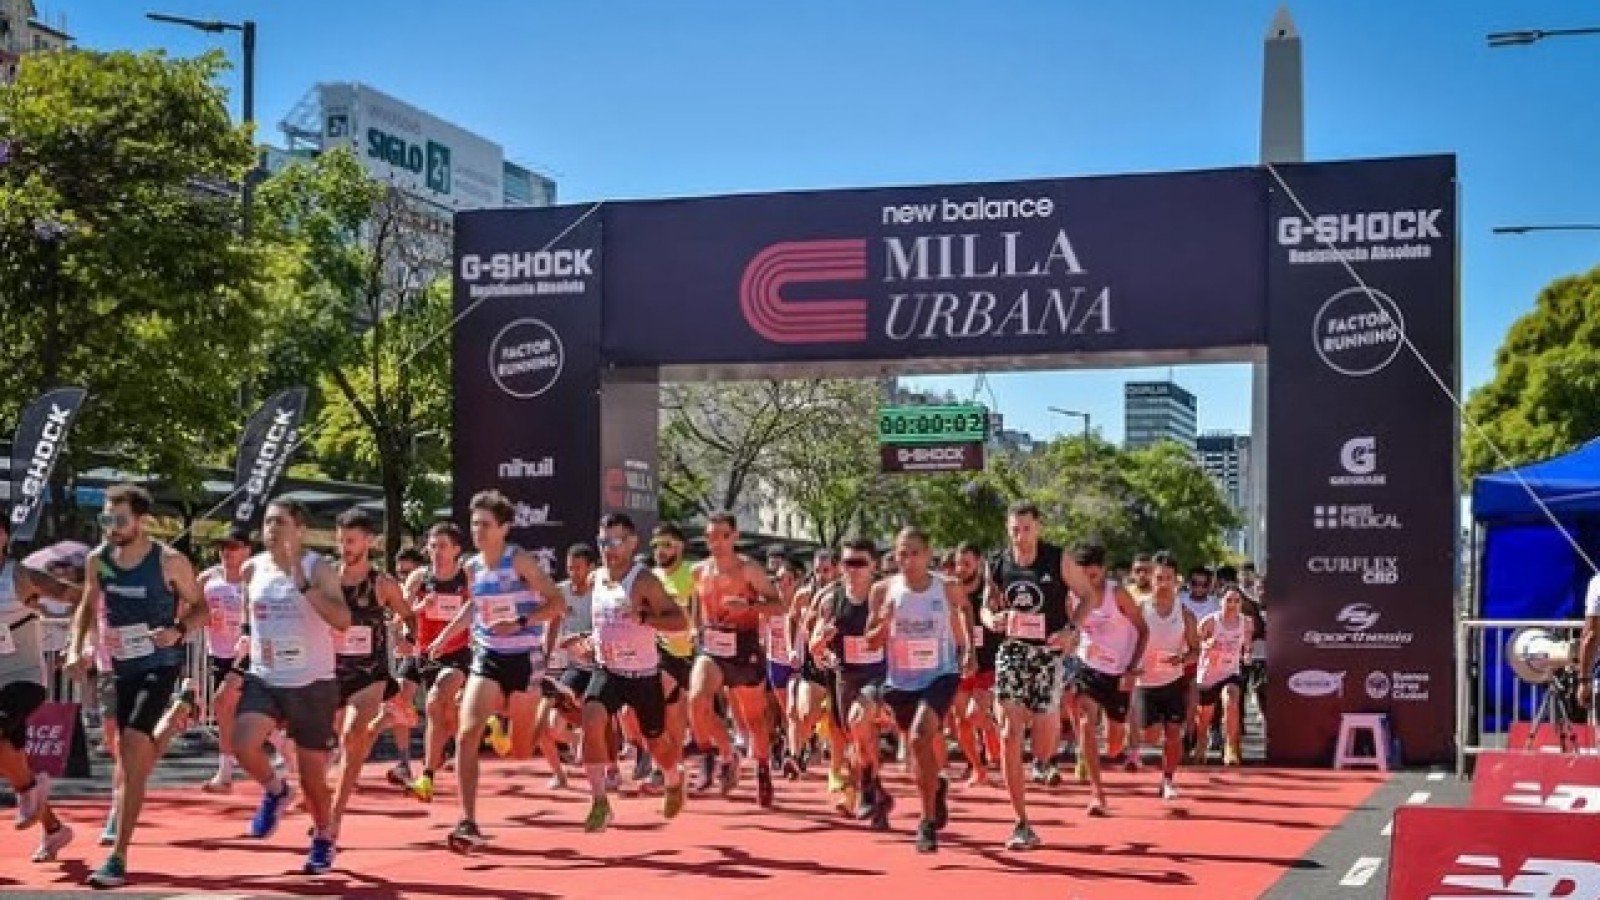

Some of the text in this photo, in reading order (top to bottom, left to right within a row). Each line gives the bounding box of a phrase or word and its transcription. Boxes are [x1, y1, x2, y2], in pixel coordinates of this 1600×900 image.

[368, 126, 424, 174] SIGLO
[882, 196, 1054, 225] new balance
[1278, 208, 1443, 246] G-SHOCK
[461, 248, 593, 281] G-SHOCK
[883, 228, 1088, 283] MILLA
[884, 286, 1118, 341] URBANA
[1327, 310, 1391, 335] FACTOR
[1323, 327, 1398, 353] RUNNING
[880, 413, 981, 435] 00:00:02
[11, 402, 70, 524] G-SHOCK
[235, 407, 296, 521] G-SHOCK
[498, 456, 554, 478] nihuil
[26, 724, 63, 739] ACE
